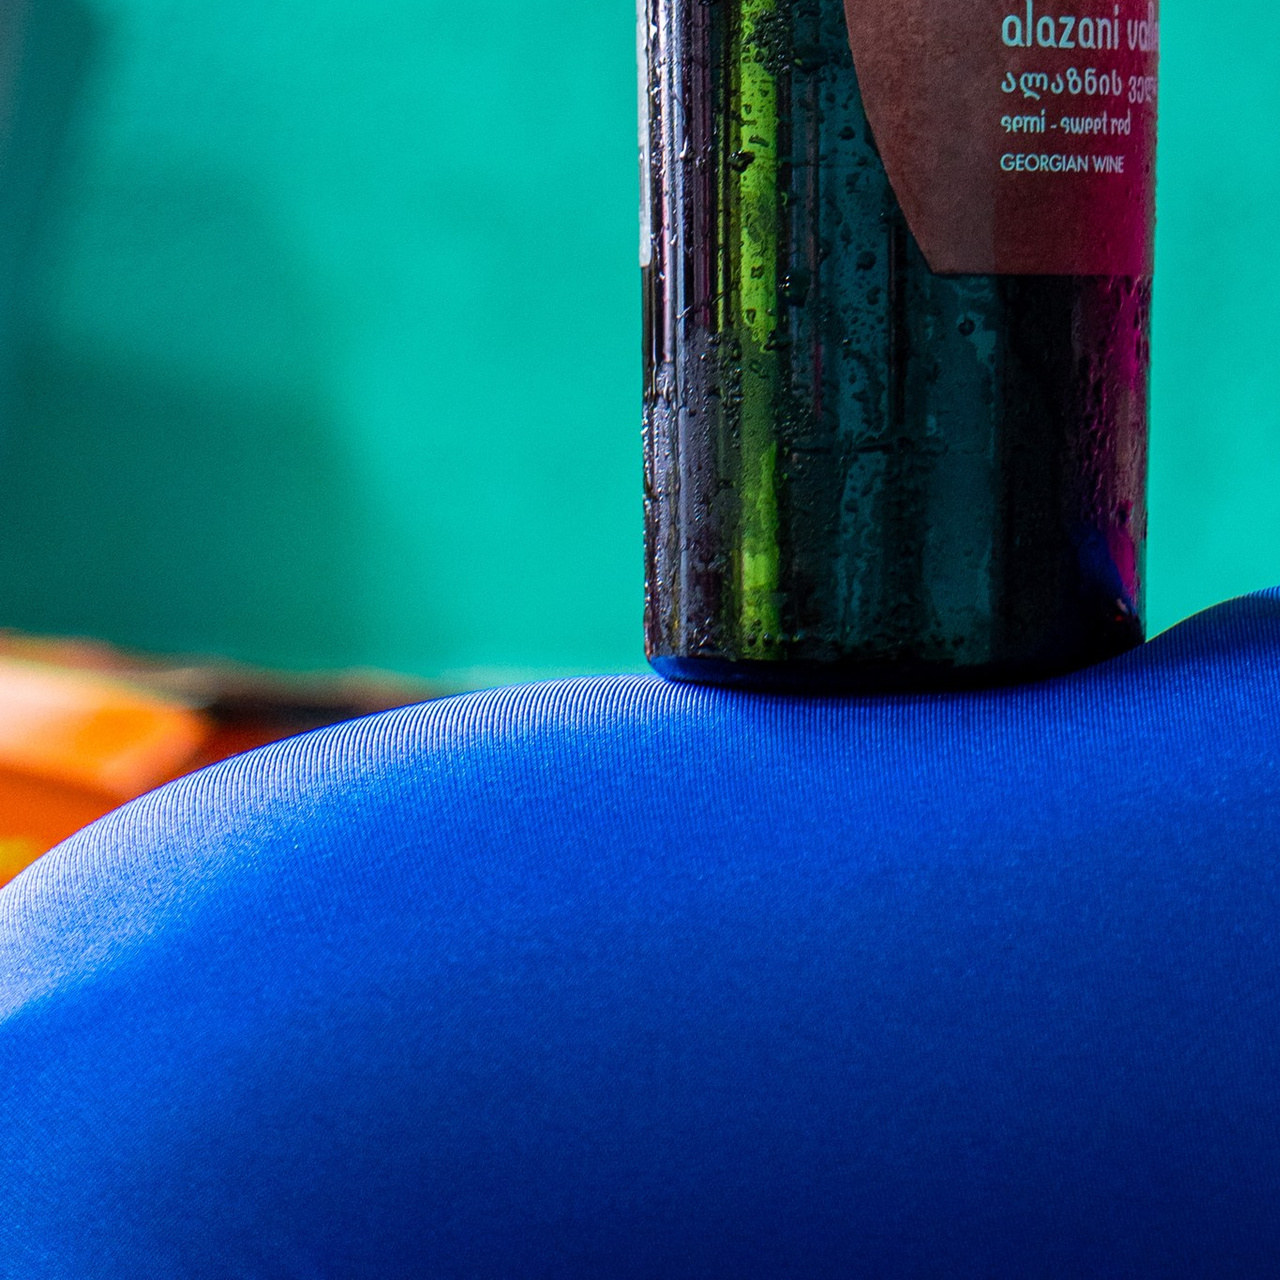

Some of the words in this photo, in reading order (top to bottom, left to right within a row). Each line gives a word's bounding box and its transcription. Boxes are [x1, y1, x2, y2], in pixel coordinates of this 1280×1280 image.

[1001, 67, 1123, 100] ალაზნის
[1001, 108, 1046, 134] semi
[1060, 111, 1107, 135] sweet
[1110, 108, 1131, 136] red
[1000, 152, 1088, 173] GEORGIAN
[1092, 154, 1125, 174] WINE
